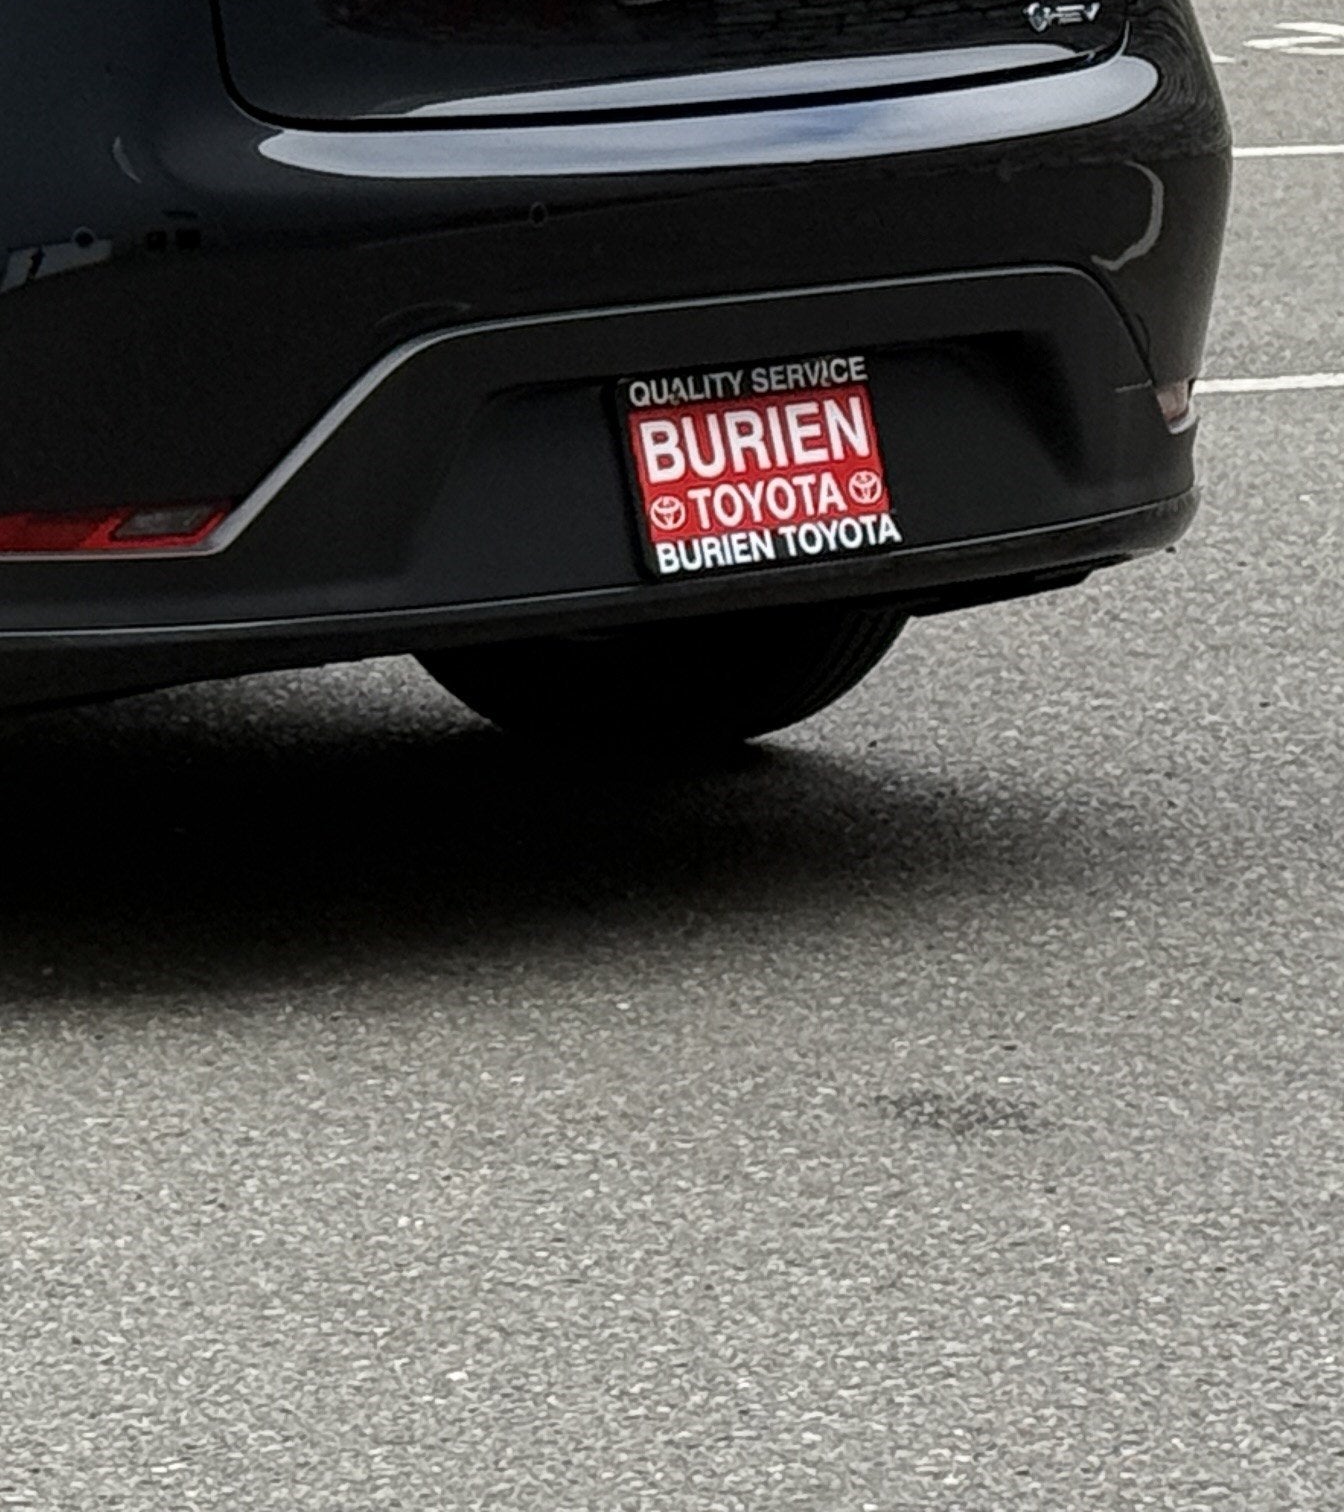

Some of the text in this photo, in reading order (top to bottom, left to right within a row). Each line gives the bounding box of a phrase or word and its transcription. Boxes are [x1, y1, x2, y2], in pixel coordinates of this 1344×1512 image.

[628, 355, 869, 408] QUALITY SERVICE
[639, 396, 871, 485] BURIEN
[687, 471, 848, 531] TOYOTA
[655, 512, 903, 575] BURIEN TOYOTA
